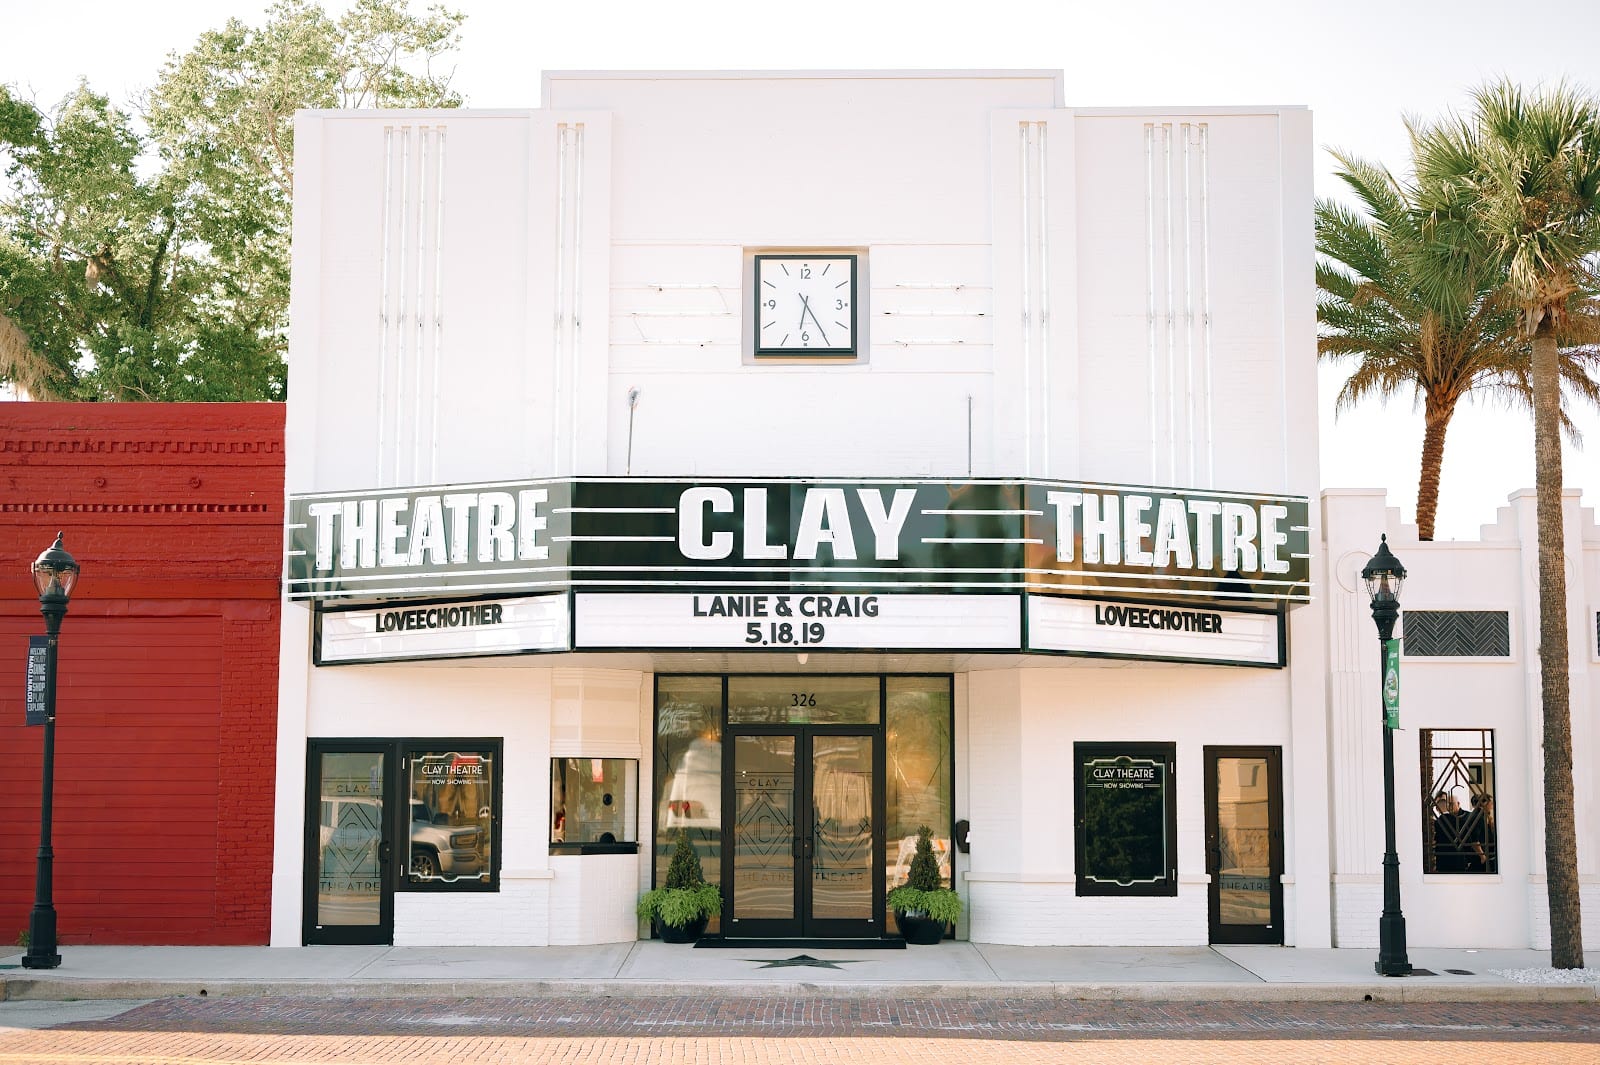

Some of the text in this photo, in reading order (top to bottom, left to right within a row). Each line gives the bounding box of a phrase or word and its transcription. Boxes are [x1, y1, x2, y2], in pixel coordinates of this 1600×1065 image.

[800, 268, 811, 279] 12
[768, 299, 776, 310] 9
[835, 299, 843, 310] 3
[801, 331, 810, 342] 6
[678, 486, 918, 561] CLAY
[308, 488, 550, 571] THEATRE
[1047, 490, 1290, 574] THEATRE
[693, 595, 879, 617] LANIE & CRAIG
[745, 622, 825, 646] 5.18.19
[33, 664, 46, 674] DINE
[32, 682, 46, 691] SHOP
[32, 692, 45, 702] PLAY
[791, 693, 817, 707] 326
[27, 702, 45, 712] EXPLORE
[421, 765, 483, 774] CLAY THEATRE
[1093, 768, 1154, 778] CLAY THEATRE
[749, 778, 779, 786] CLAY
[336, 784, 368, 793] CLAY
[736, 872, 792, 881] HEATRE
[815, 872, 864, 882] THEATR
